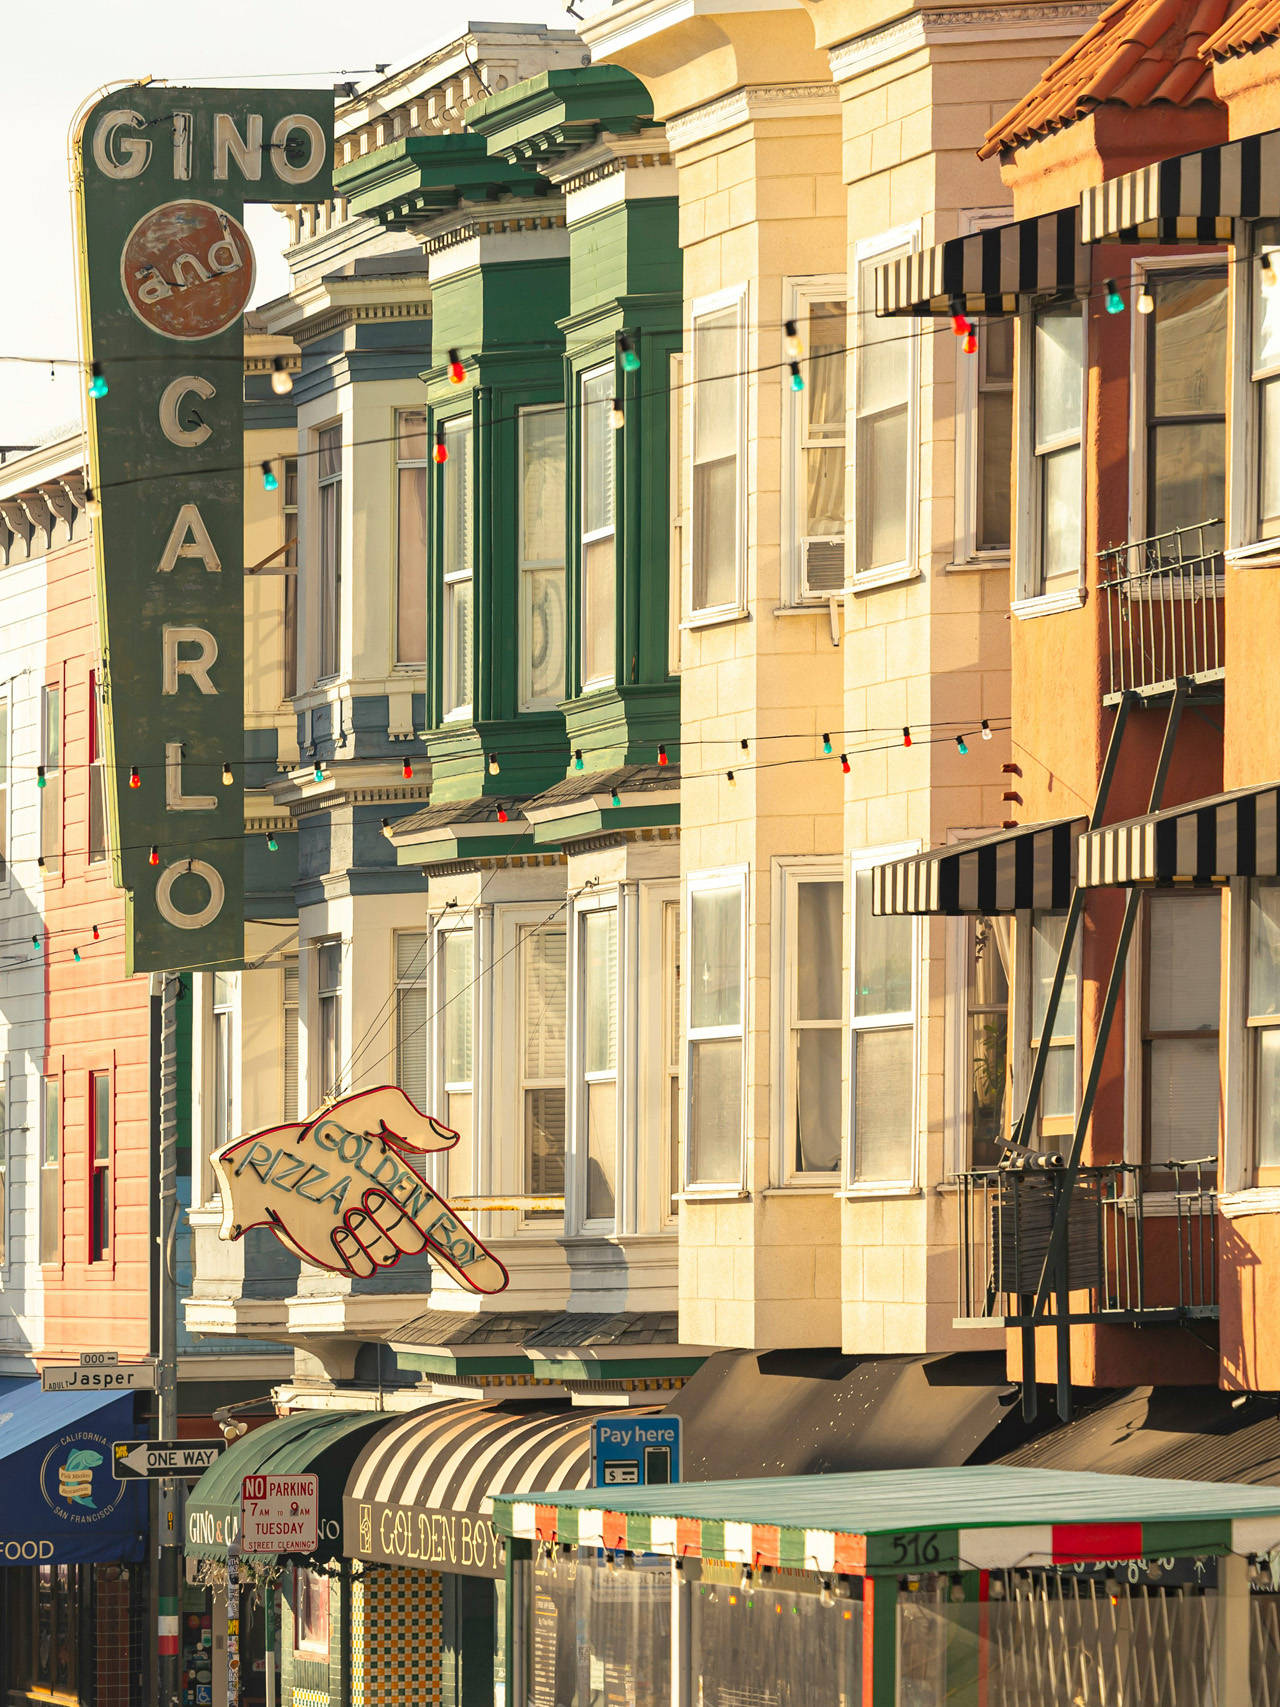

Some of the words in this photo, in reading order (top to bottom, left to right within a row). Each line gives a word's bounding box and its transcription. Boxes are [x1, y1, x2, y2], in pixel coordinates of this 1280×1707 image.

[93, 109, 326, 185] GINO
[134, 211, 243, 304] and
[154, 375, 225, 930] CARLO
[235, 1141, 352, 1215] PIZZA
[314, 1119, 434, 1220] GOLDEN
[425, 1212, 486, 1267] BOY
[48, 1381, 69, 1390] ADULT
[69, 1371, 134, 1388] Jasper
[60, 1431, 107, 1446] CALIFORNIA
[600, 1427, 632, 1446] Pay
[635, 1425, 675, 1442] here
[147, 1452, 177, 1466] ONE
[183, 1451, 215, 1465] WAY
[245, 1478, 264, 1497] NO
[270, 1481, 313, 1497] PARKING
[53, 1505, 67, 1520] SAN
[70, 1504, 114, 1524] FRANCISCO
[189, 1510, 214, 1544] GINO
[216, 1520, 223, 1543] &
[255, 1522, 304, 1535] TUESDAY
[248, 1540, 274, 1549] STREET
[277, 1540, 311, 1549] CLEANING
[380, 1508, 456, 1564] GOLDEN
[461, 1517, 499, 1569] BOY
[893, 1533, 939, 1564] 516
